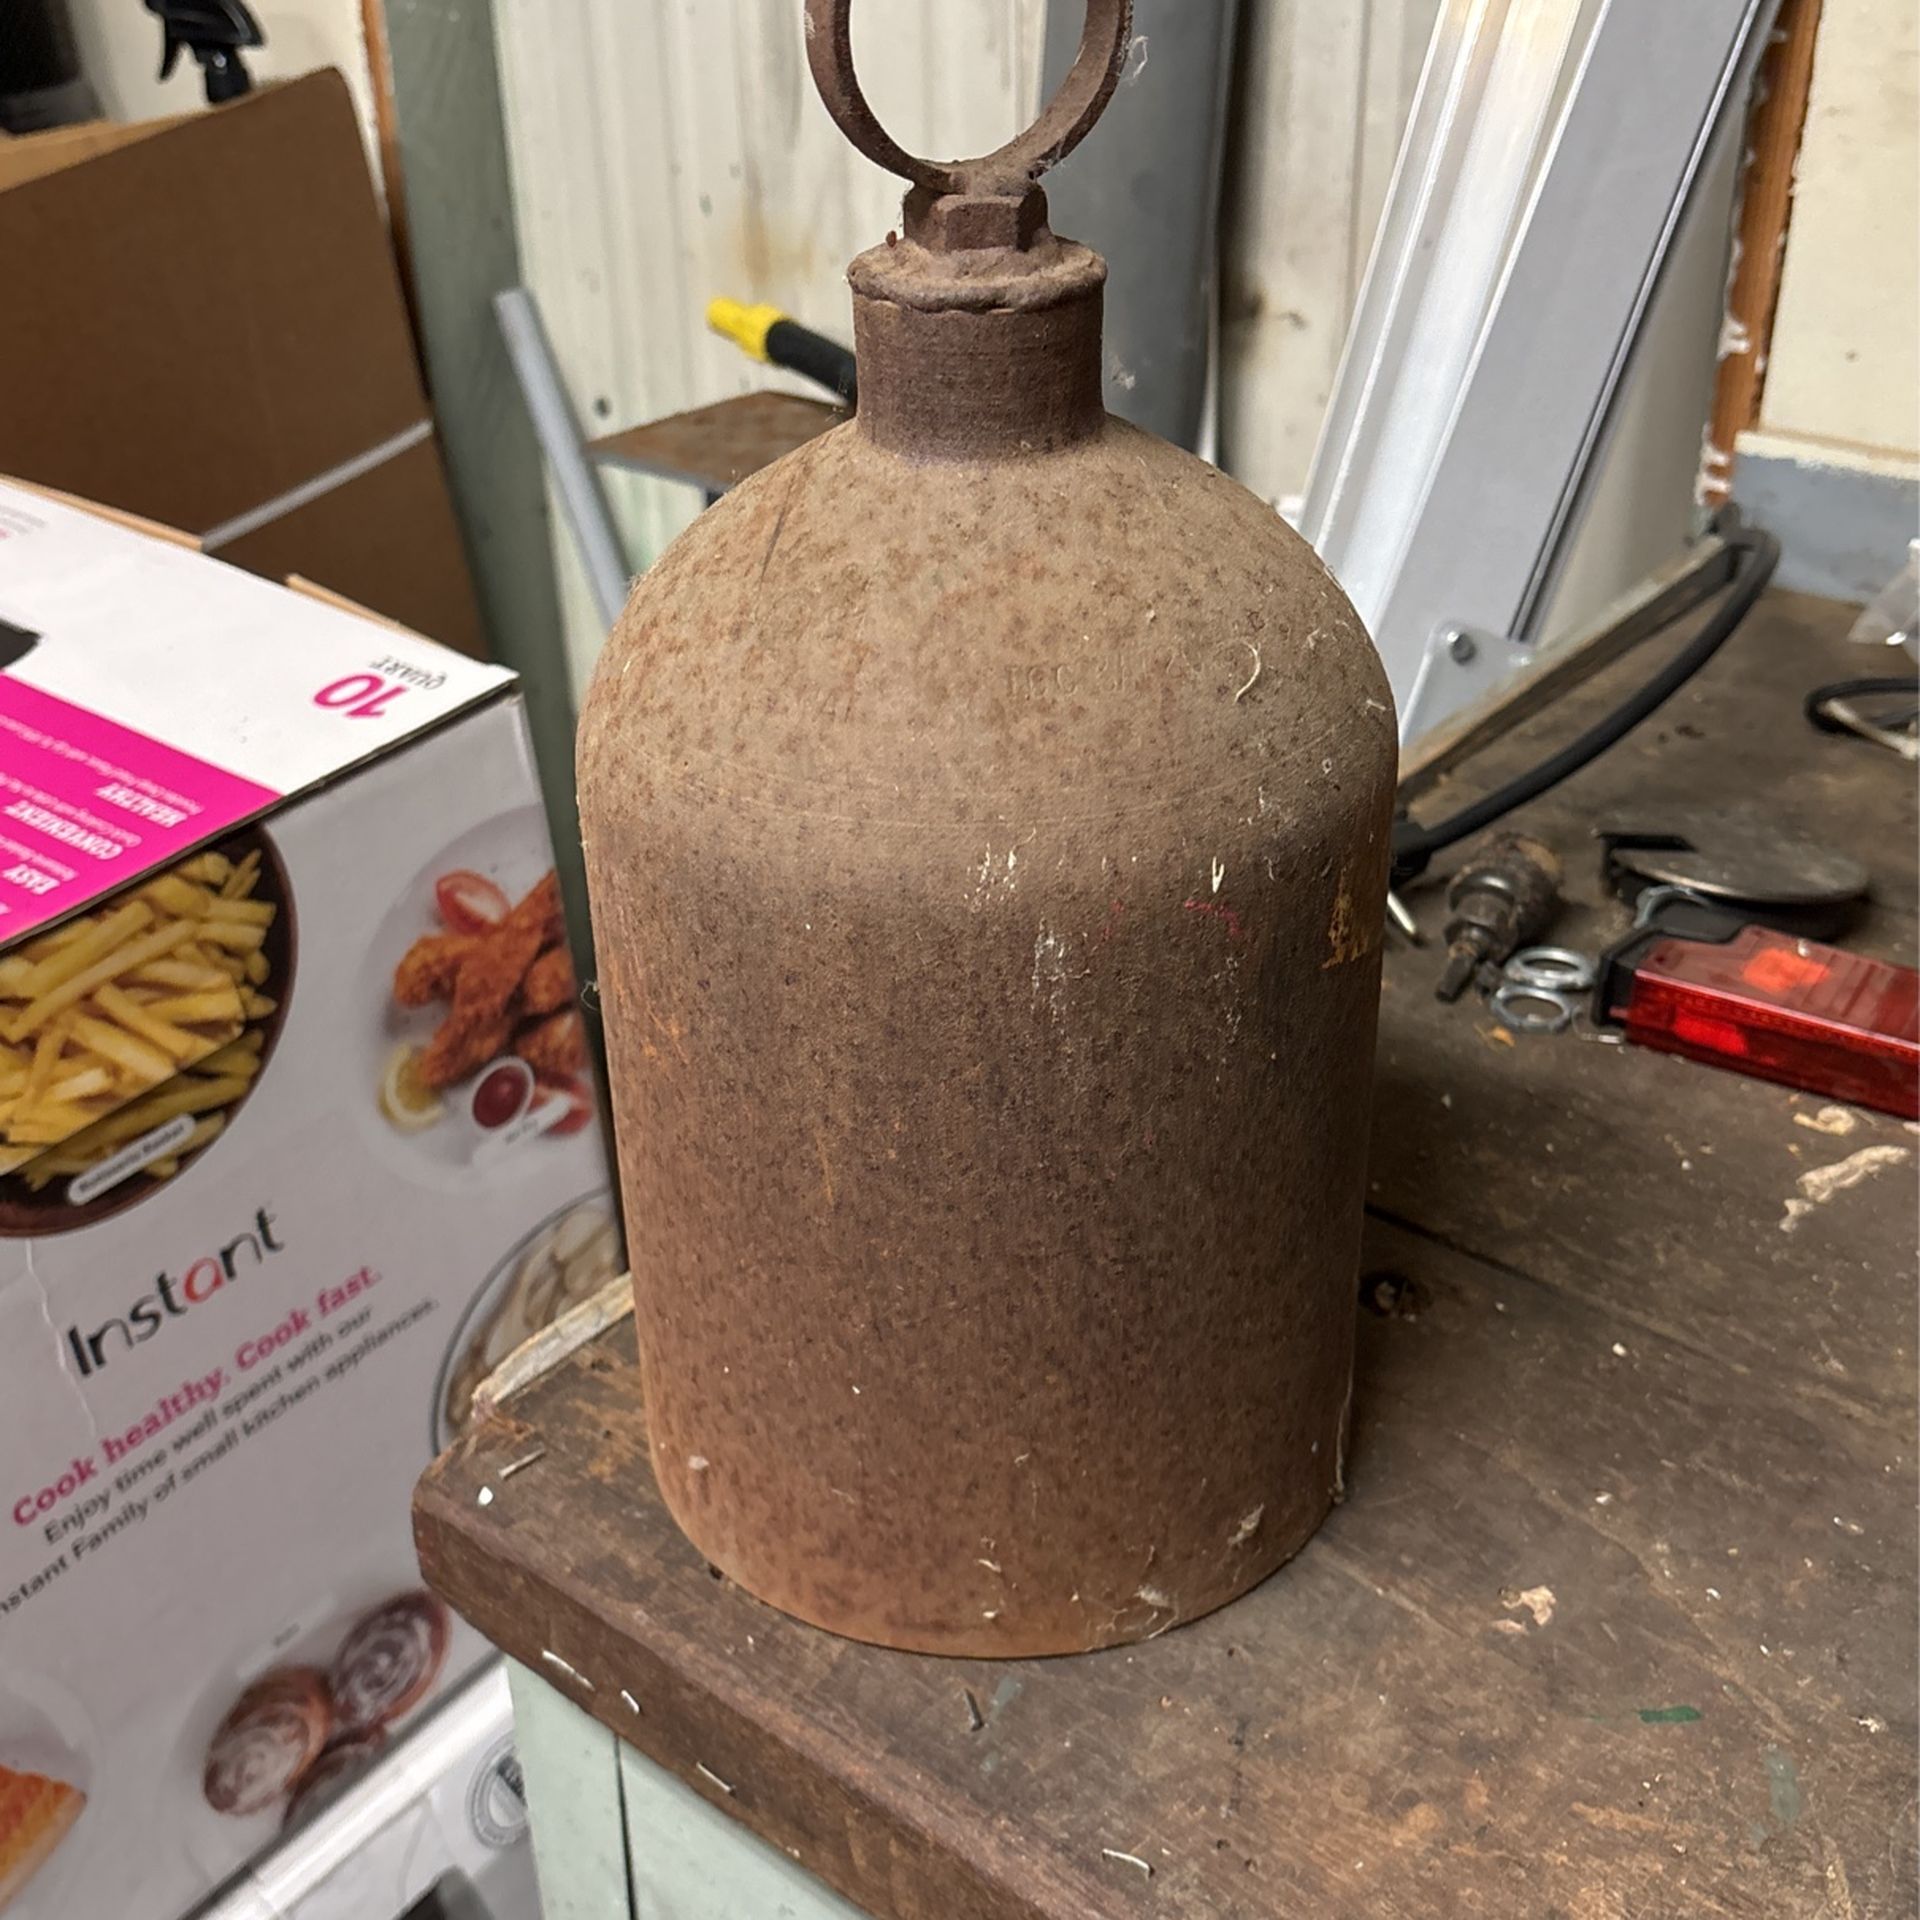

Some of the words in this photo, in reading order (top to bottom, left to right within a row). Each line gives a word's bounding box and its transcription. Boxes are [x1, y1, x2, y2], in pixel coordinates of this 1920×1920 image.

[313, 674, 408, 718] 10
[369, 655, 447, 690] QUART
[3, 800, 123, 860] CONVENIENT
[95, 783, 188, 828] HEALTHY
[3, 864, 60, 895] EASY
[68, 1207, 284, 1377] Instant
[13, 1456, 98, 1526] Cook
[101, 1367, 230, 1466] healthy.
[235, 1308, 312, 1371] Cook
[316, 1266, 381, 1318] fast.
[44, 1488, 110, 1545] Enjoy
[114, 1449, 167, 1492] time
[172, 1407, 217, 1453] well
[222, 1365, 281, 1418] spent
[286, 1331, 333, 1373] with
[337, 1306, 373, 1338] our
[0, 1555, 68, 1619] nstant
[71, 1498, 149, 1560] Family
[154, 1469, 177, 1503] of
[181, 1428, 238, 1481] small
[242, 1376, 320, 1438] kitchen
[325, 1298, 438, 1382] appliances.
